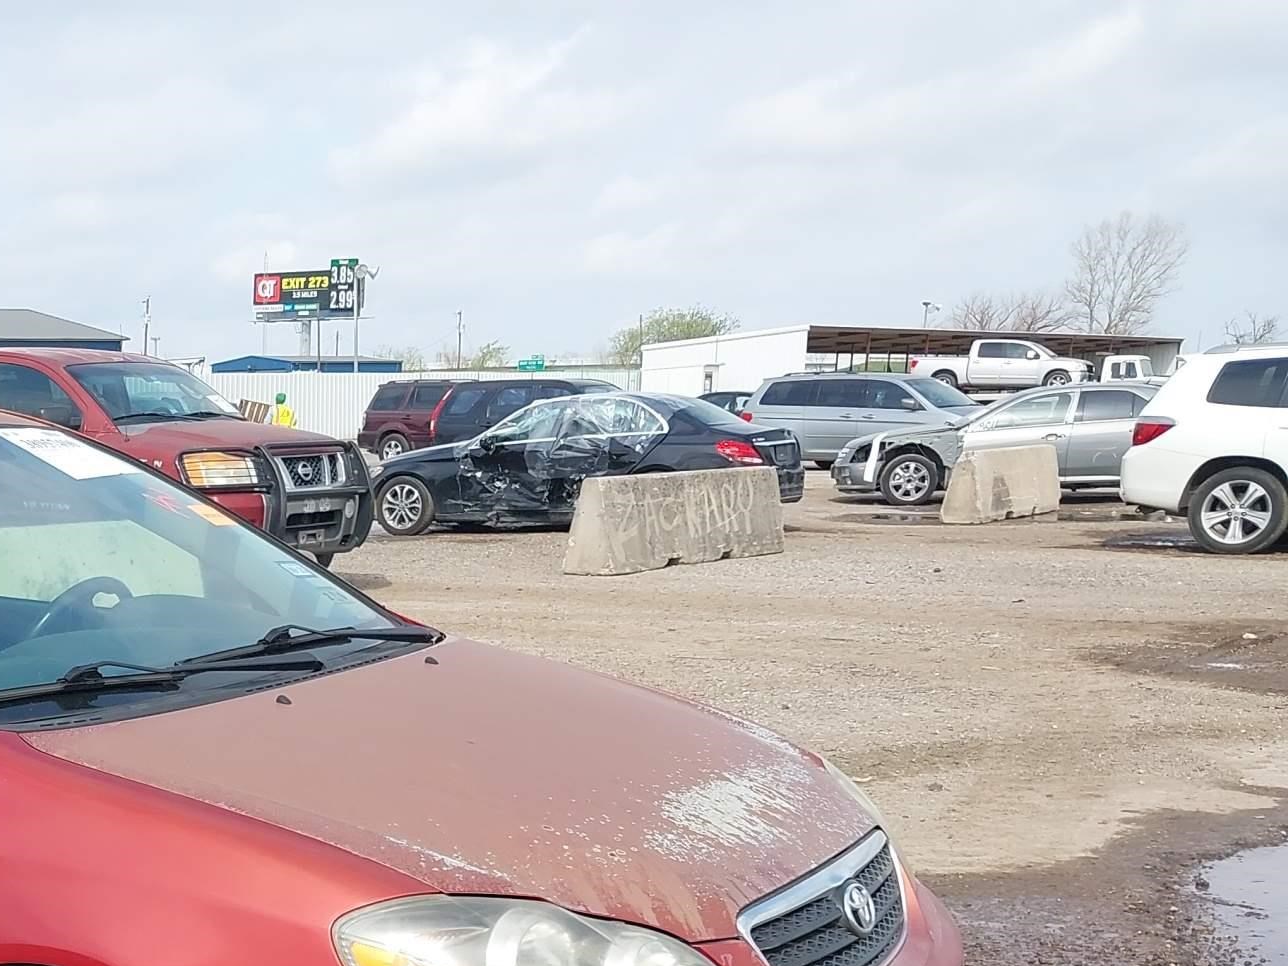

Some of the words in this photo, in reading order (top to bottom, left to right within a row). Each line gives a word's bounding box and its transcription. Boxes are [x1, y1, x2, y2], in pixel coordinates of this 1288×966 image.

[282, 277, 306, 290] EXIT
[308, 276, 329, 289] 273
[331, 266, 353, 284] 3.85
[257, 279, 277, 298] QT
[330, 290, 353, 309] 2.99
